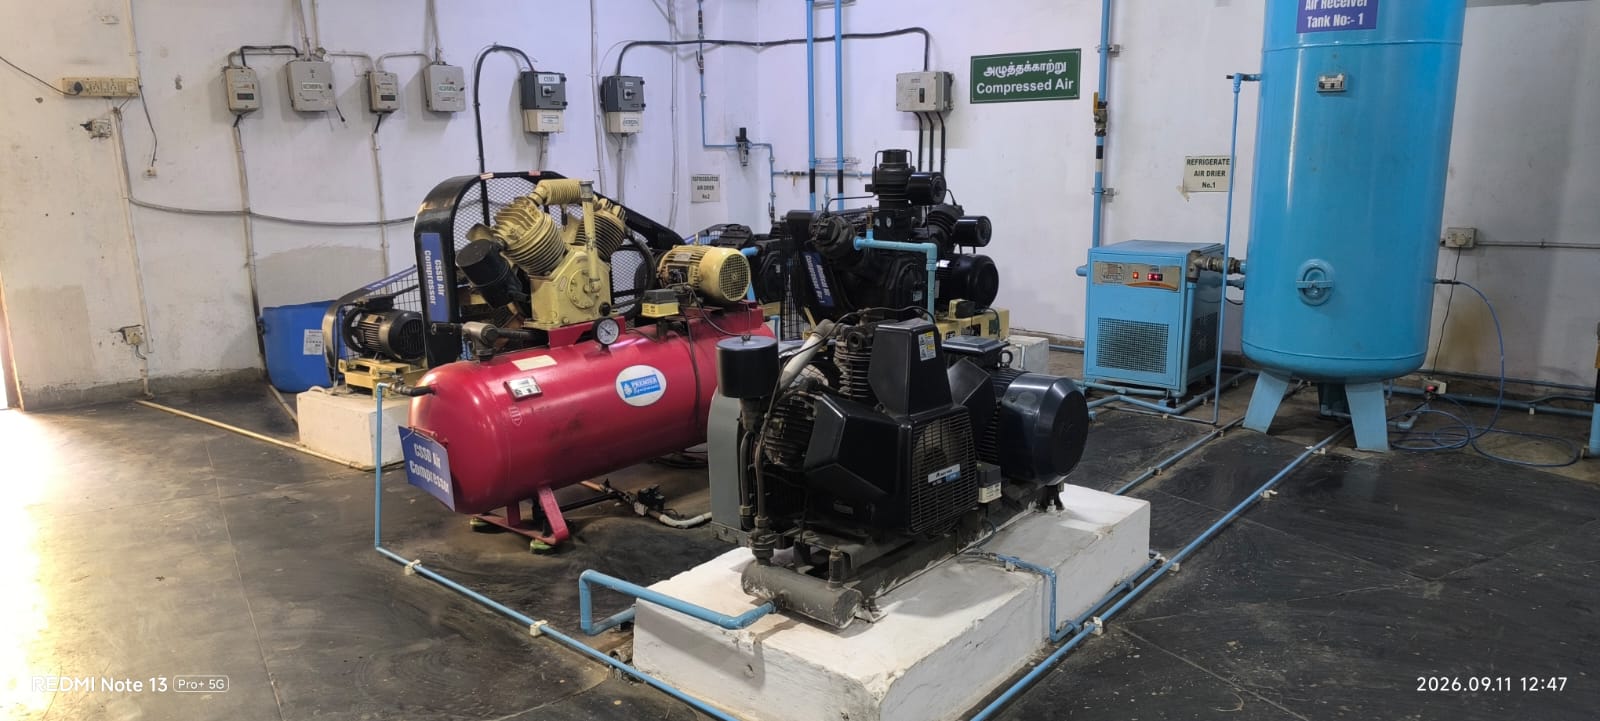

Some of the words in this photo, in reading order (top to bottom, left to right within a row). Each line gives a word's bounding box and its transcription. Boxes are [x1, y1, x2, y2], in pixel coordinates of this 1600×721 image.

[1305, 0, 1317, 10] Air
[1321, 0, 1368, 10] Receiver
[1307, 15, 1331, 28] Tank
[1358, 13, 1364, 25] 1
[983, 59, 1067, 78] அழுத்தக்காற்று
[976, 79, 1052, 95] Compressed
[1055, 78, 1074, 90] Air
[1186, 158, 1232, 166] REFRIGERATE
[424, 250, 436, 305] Compressor
[434, 260, 444, 282] CSSD
[437, 283, 446, 297] Air
[414, 443, 431, 463] CSSD
[432, 452, 440, 469] Air
[409, 460, 449, 494] Compressor
